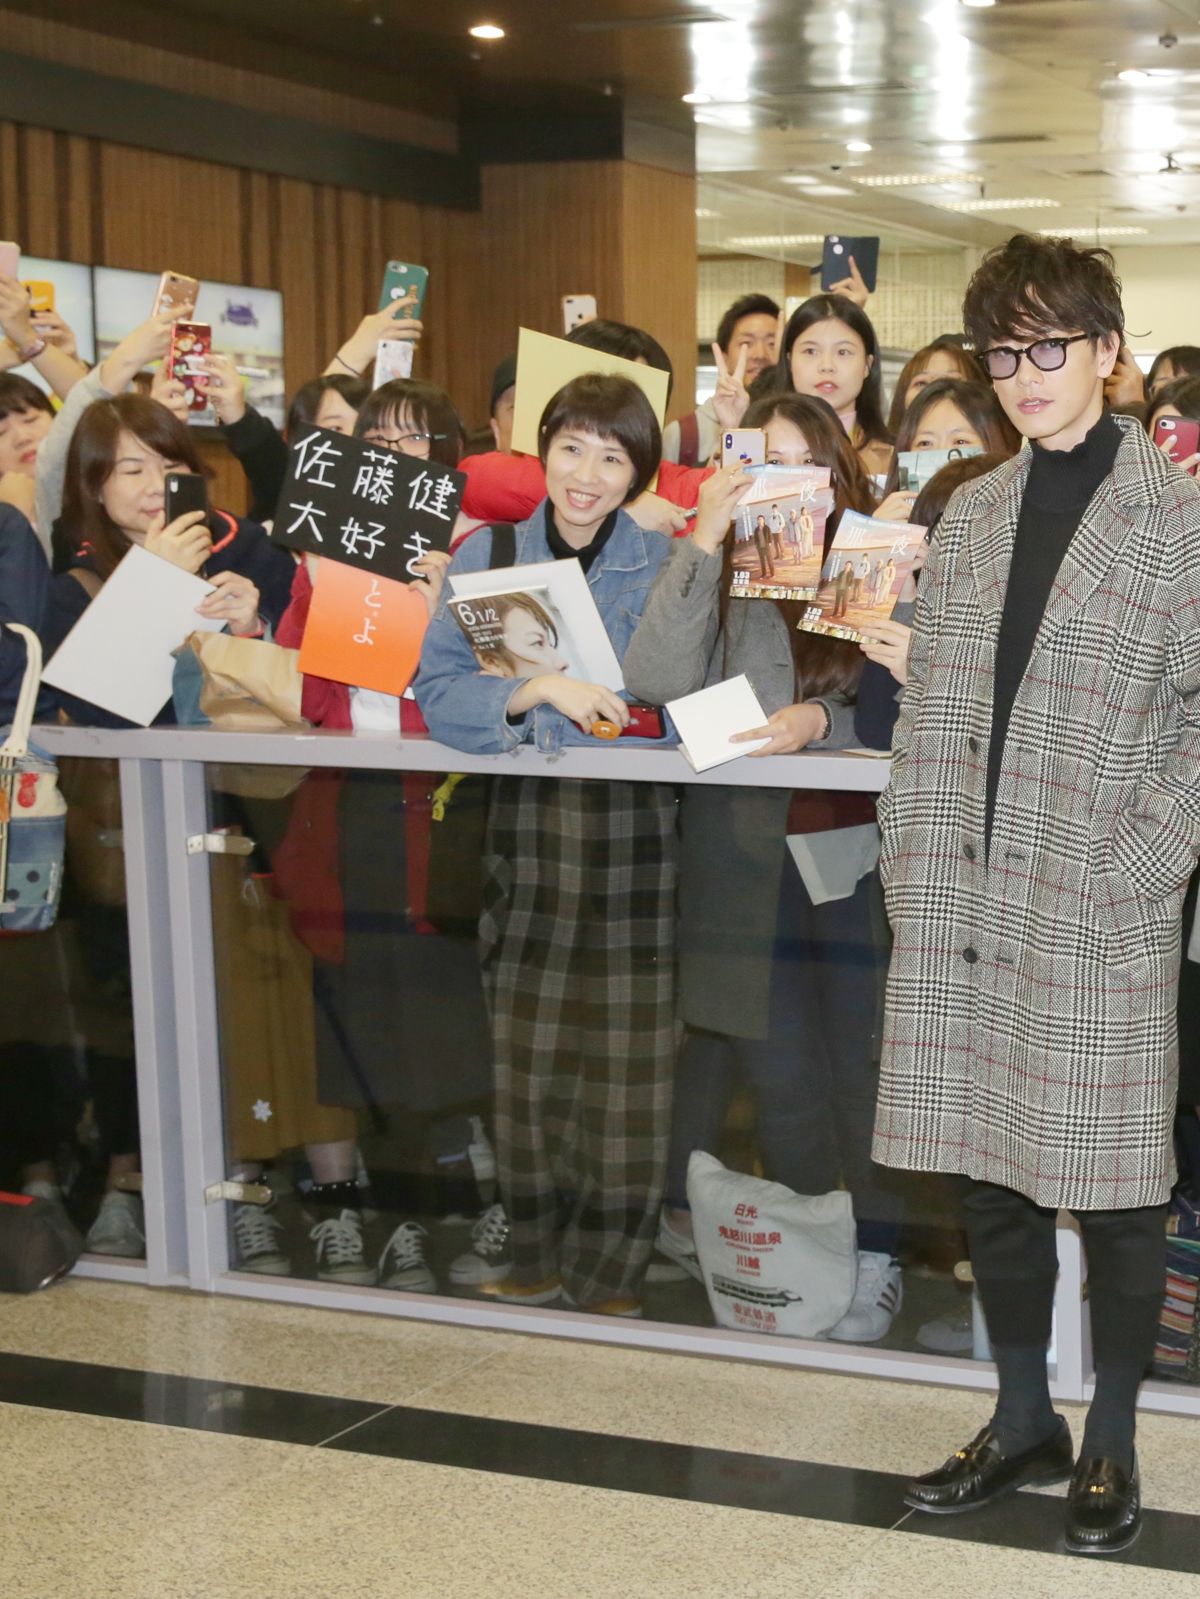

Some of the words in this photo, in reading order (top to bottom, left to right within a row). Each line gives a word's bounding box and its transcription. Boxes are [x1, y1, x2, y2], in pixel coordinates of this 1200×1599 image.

[293, 430, 457, 521] 佐藤健
[286, 500, 432, 578] 大好き
[734, 1203, 758, 1219] 日光
